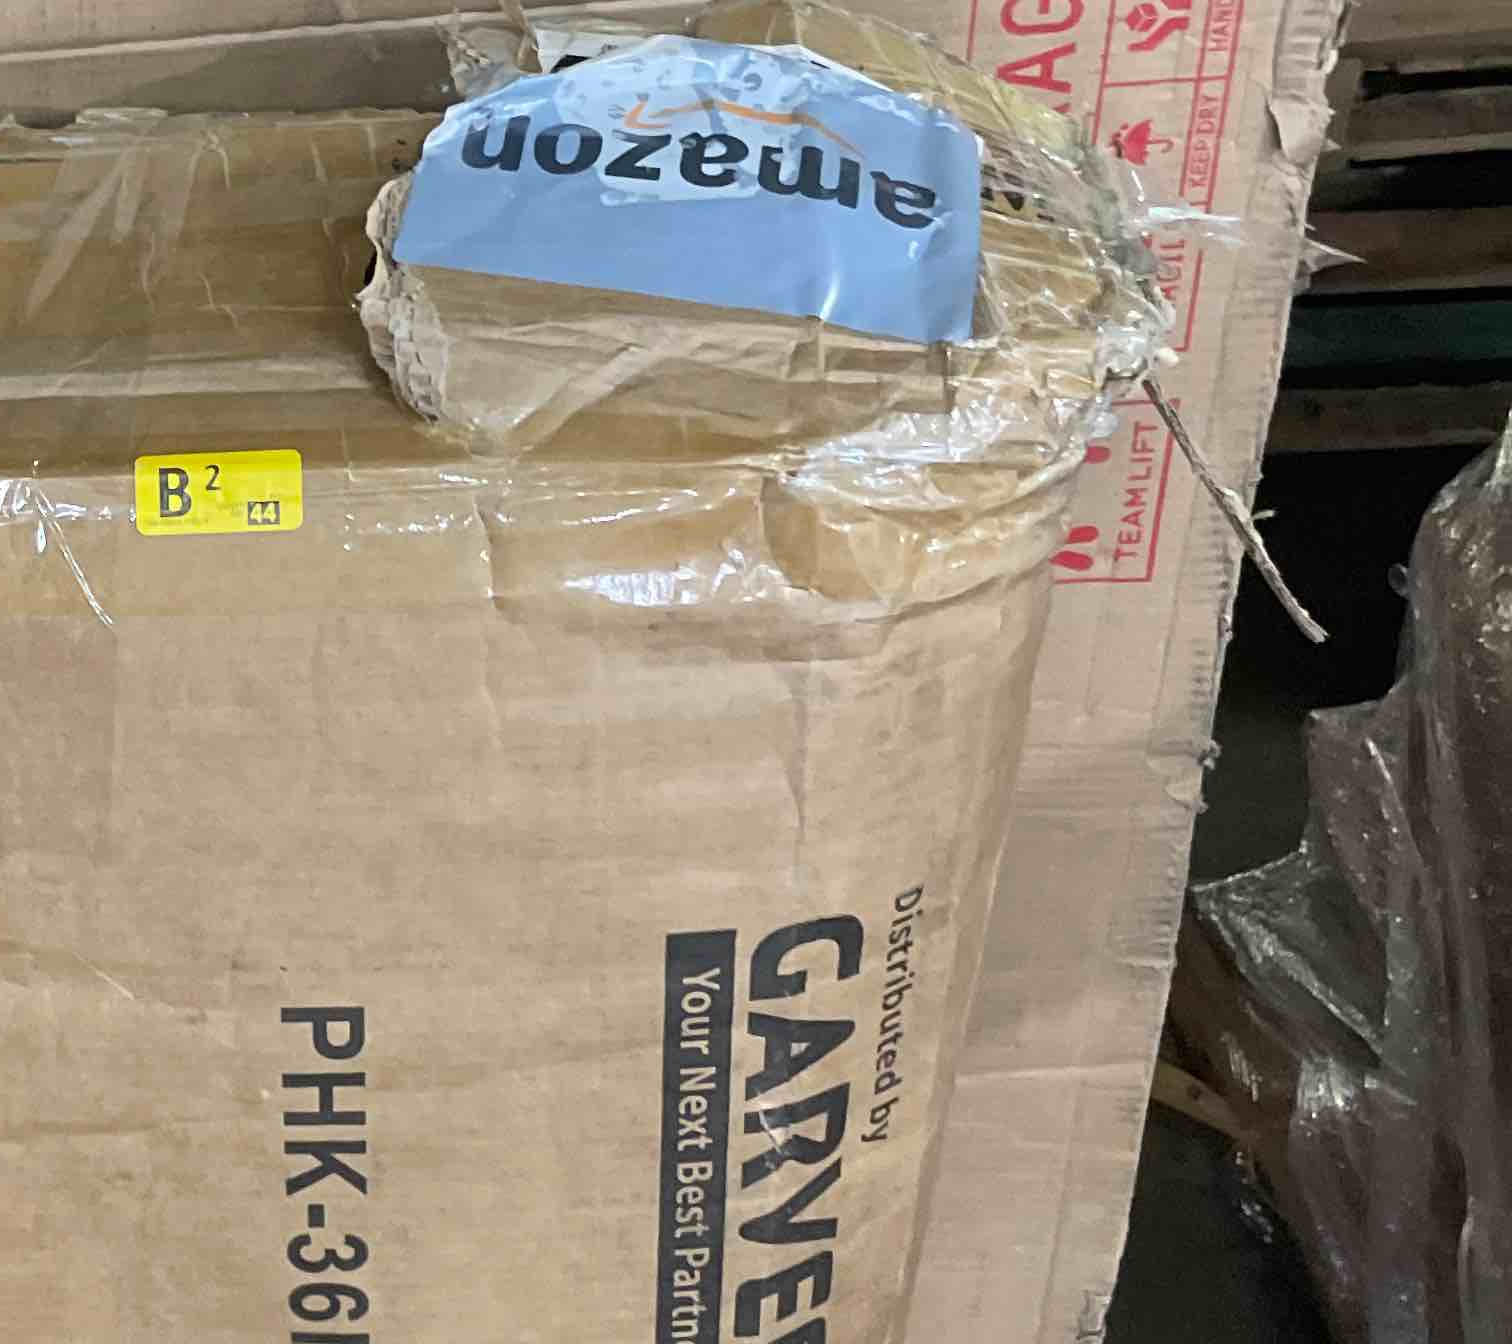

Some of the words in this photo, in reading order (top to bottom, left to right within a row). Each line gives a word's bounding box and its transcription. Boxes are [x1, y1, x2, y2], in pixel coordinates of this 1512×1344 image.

[461, 114, 937, 229] amazon
[1191, 140, 1211, 188] KEEP
[159, 467, 192, 517] B
[205, 464, 221, 491] 2
[250, 502, 276, 523] 44
[1114, 481, 1148, 562] TEAM
[1134, 422, 1159, 474] LIFT
[681, 967, 720, 1053] Your
[873, 884, 925, 1094] Distributed
[677, 1066, 716, 1150] Next
[861, 1097, 900, 1143] by
[673, 1161, 714, 1237] Best
